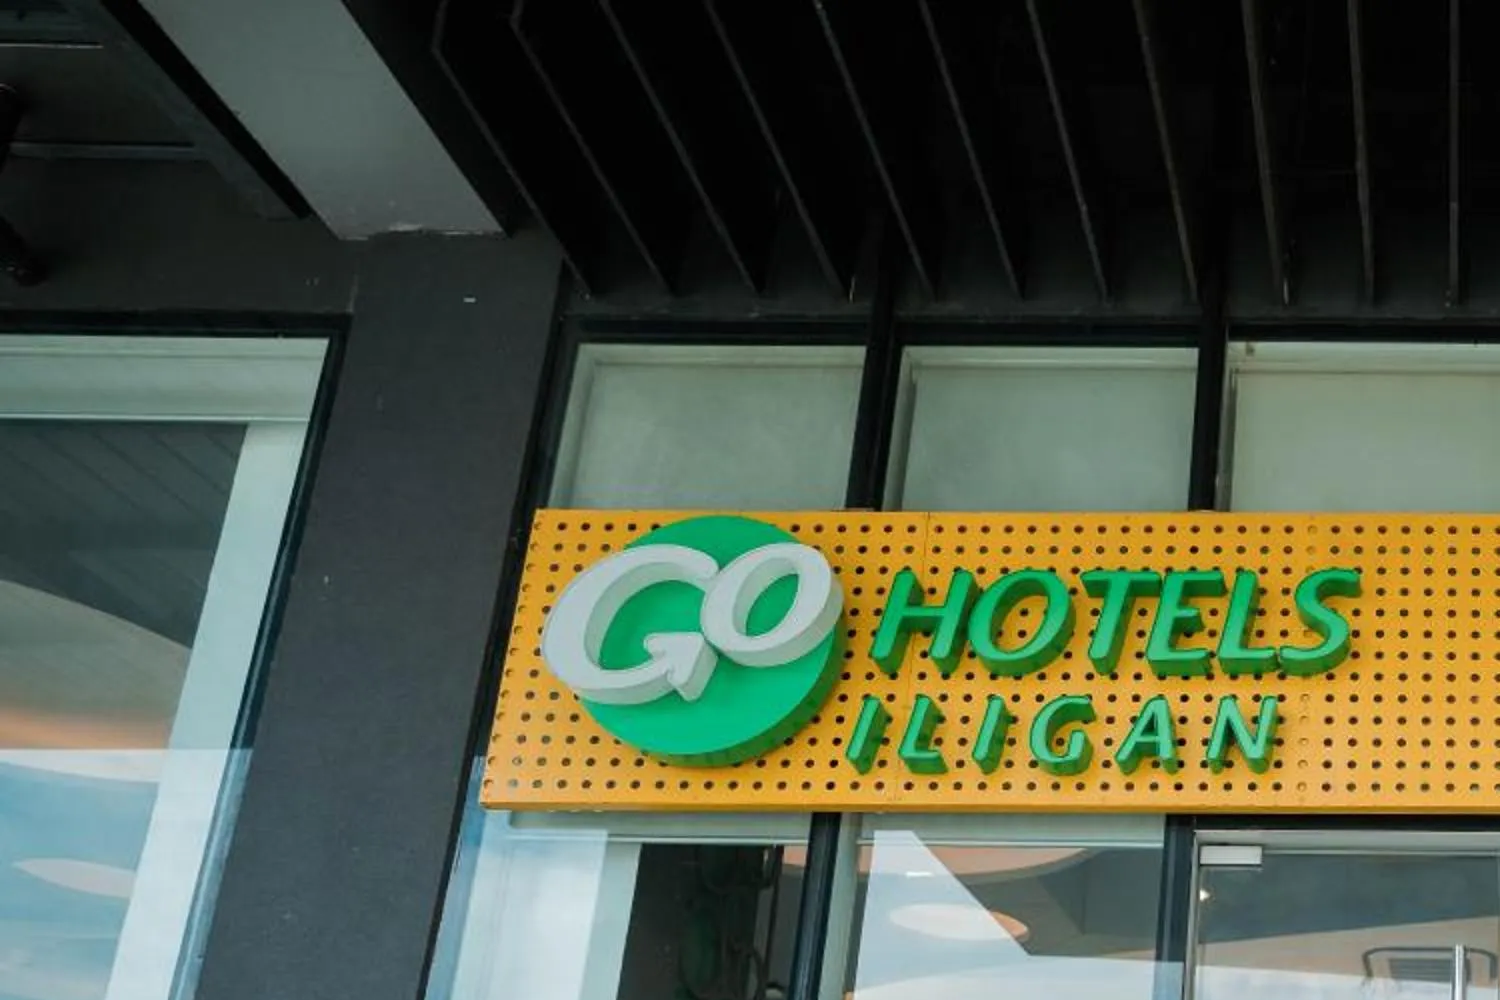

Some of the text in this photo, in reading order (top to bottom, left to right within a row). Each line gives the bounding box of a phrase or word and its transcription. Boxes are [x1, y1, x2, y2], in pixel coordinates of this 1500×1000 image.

[541, 542, 844, 706] GO
[868, 568, 1362, 676] HOTELS
[845, 695, 1279, 775] ILIGAN
